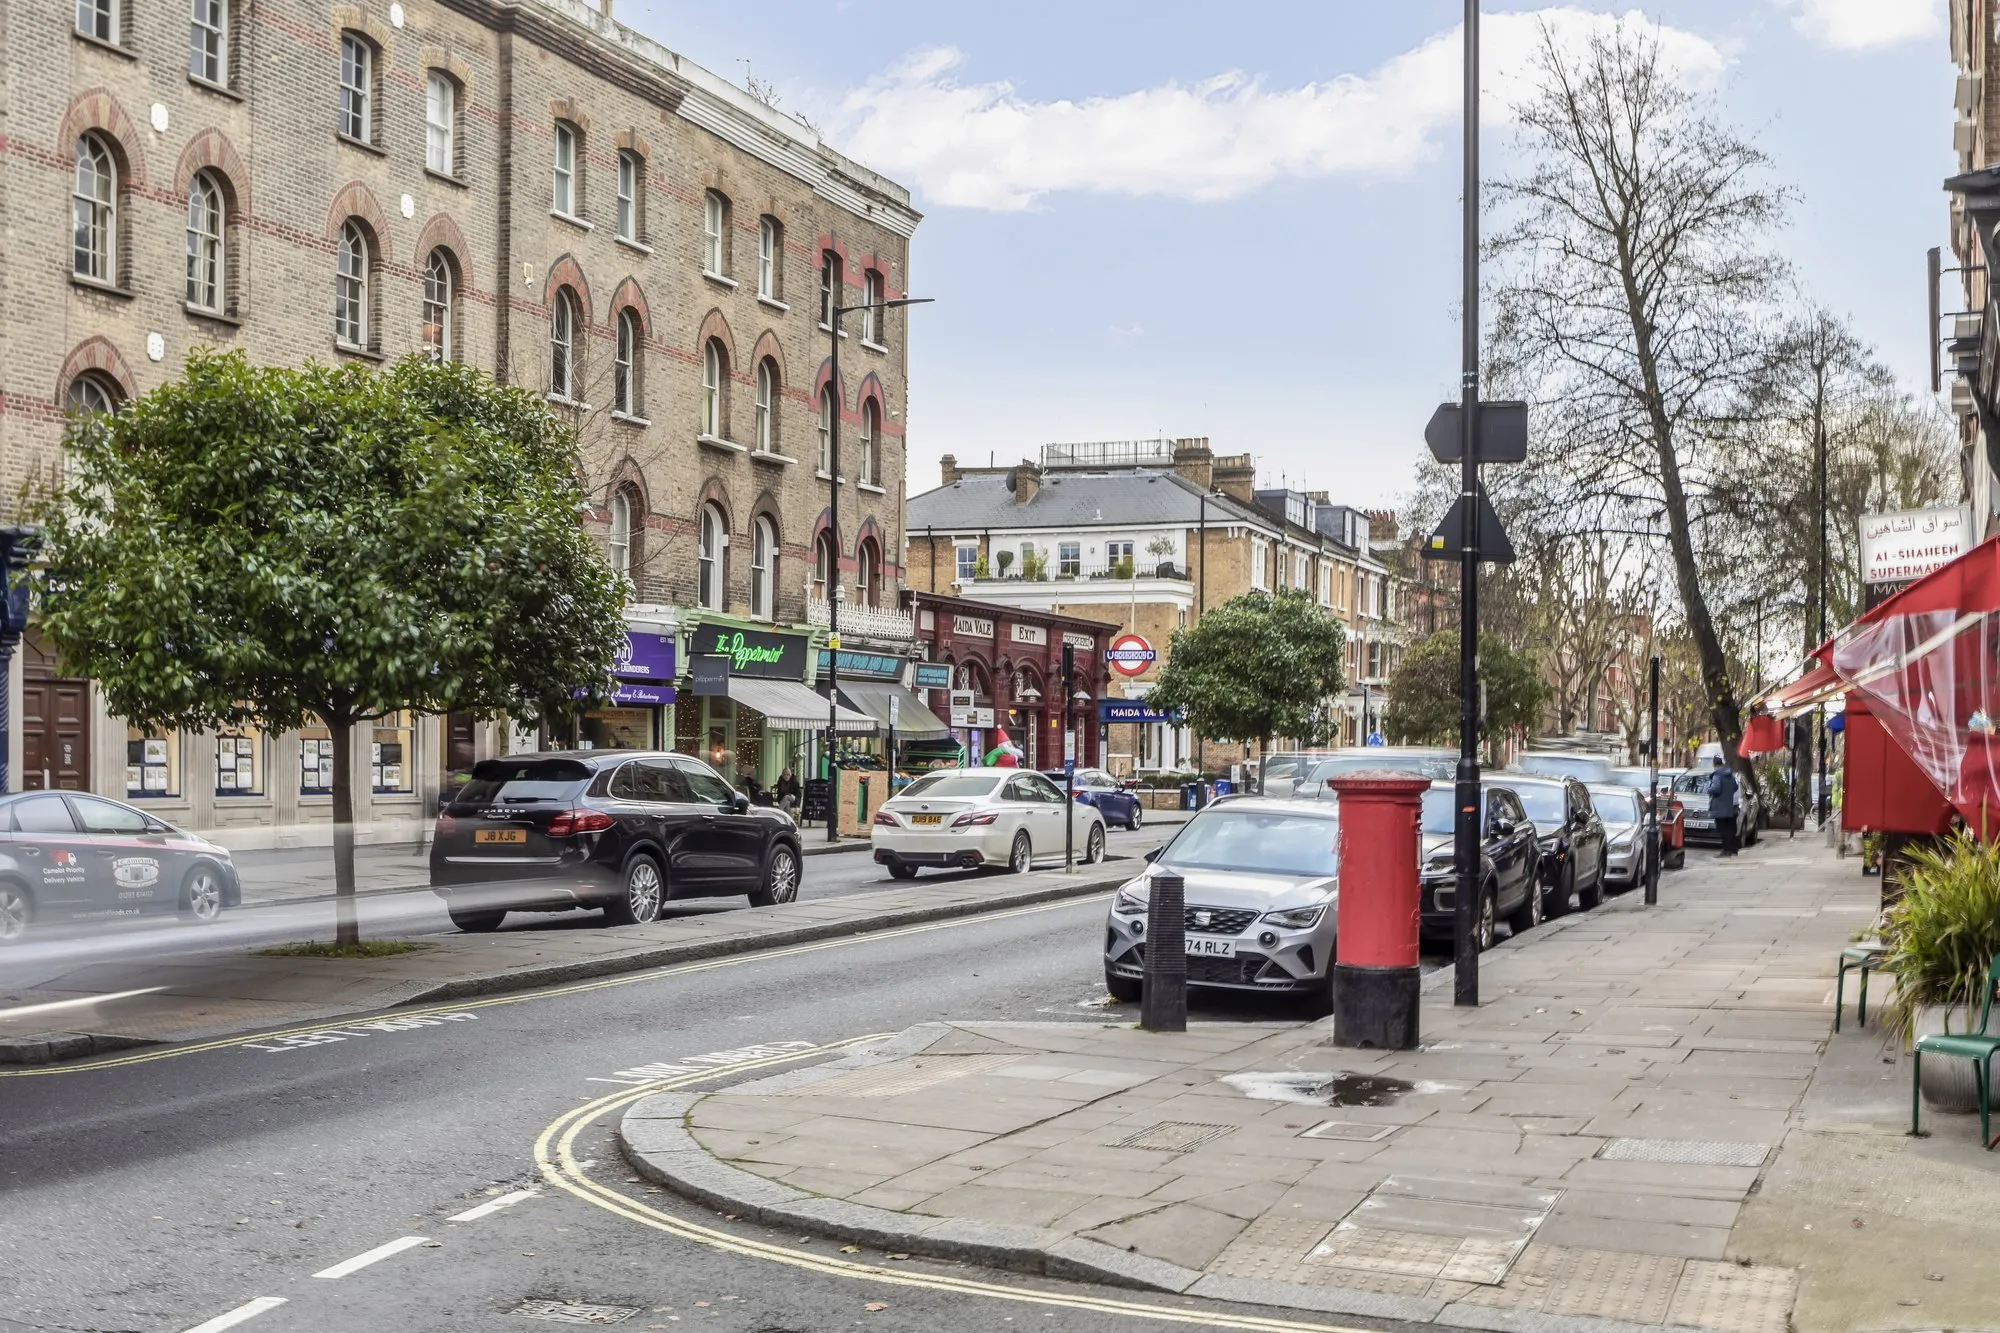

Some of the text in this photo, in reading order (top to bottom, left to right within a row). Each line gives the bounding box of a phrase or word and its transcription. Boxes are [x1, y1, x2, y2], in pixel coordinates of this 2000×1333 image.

[974, 619, 992, 636] VALE
[1019, 626, 1036, 642] EXIT
[1063, 634, 1095, 651] NDERGROUND
[730, 632, 785, 670] Peppermint
[1106, 651, 1154, 660] UNDERGROUND
[1110, 708, 1165, 717] MAIDA VAE
[484, 831, 516, 841] J8 XJG
[1204, 941, 1230, 955] RLZ
[241, 1014, 468, 1053] LOOK LEFT
[584, 1042, 801, 1085] LOOK RIGHT
